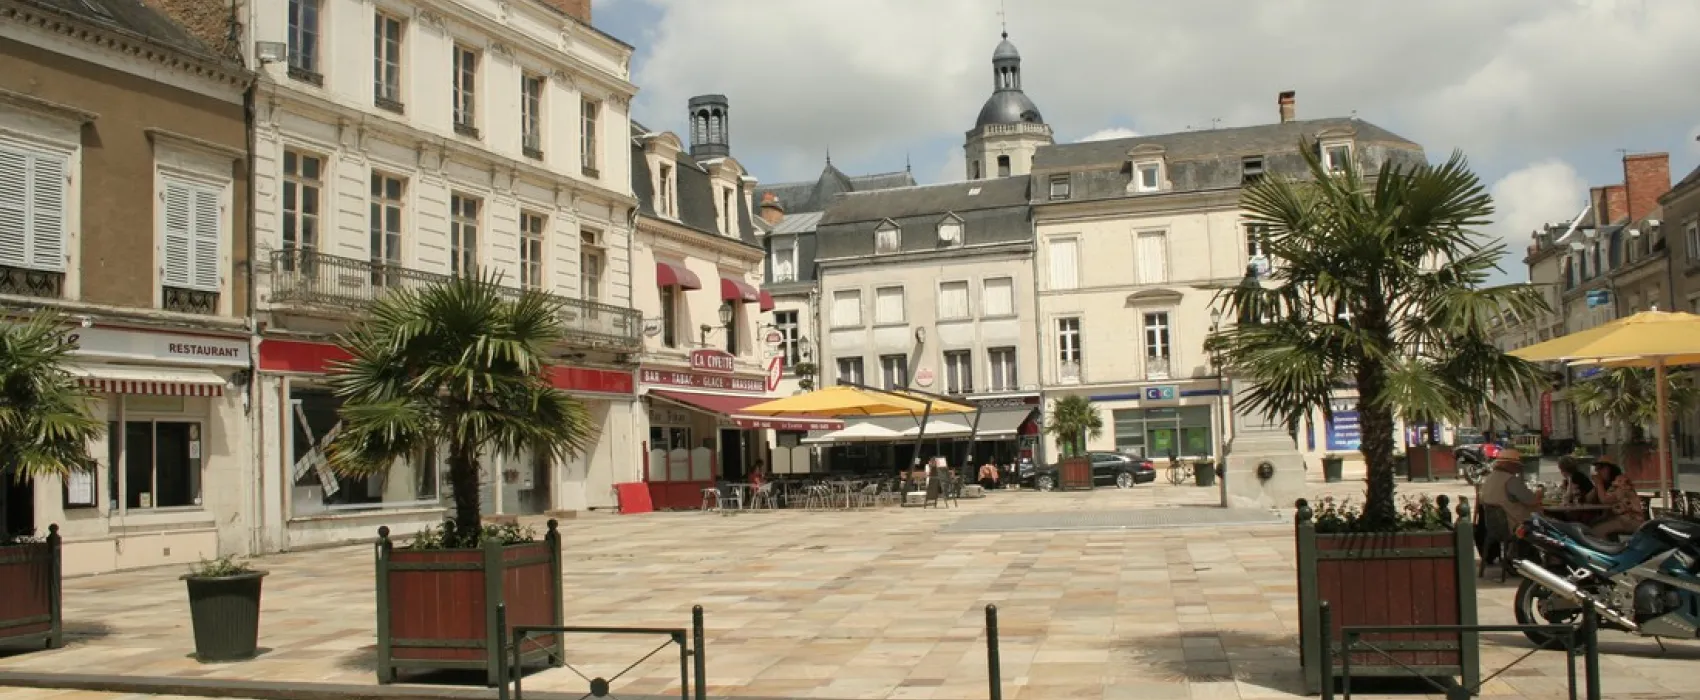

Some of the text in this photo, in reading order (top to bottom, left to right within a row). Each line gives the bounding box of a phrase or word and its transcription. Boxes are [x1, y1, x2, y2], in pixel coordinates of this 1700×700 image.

[169, 343, 239, 357] RESTAURANT
[707, 355, 733, 369] CIVETTE
[644, 370, 763, 391] BAR TABAC GLACE BRASSERIE
